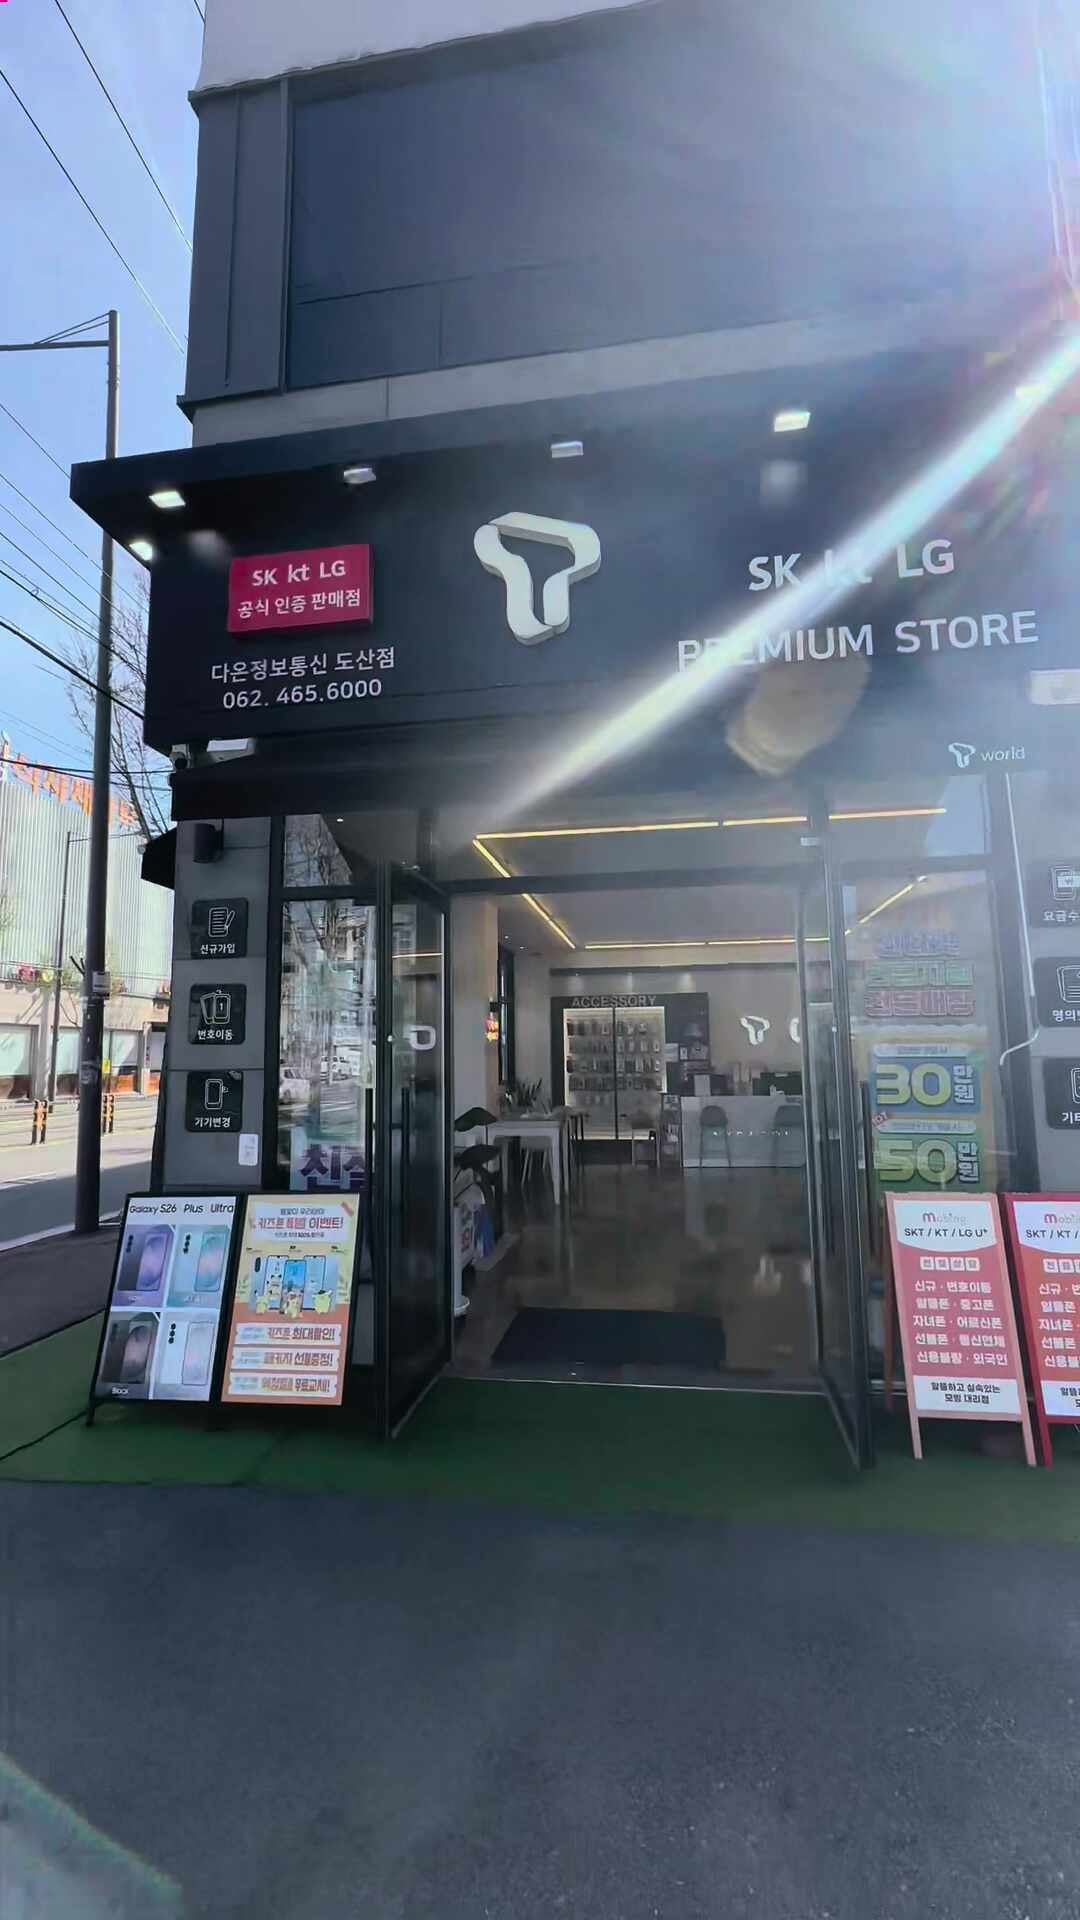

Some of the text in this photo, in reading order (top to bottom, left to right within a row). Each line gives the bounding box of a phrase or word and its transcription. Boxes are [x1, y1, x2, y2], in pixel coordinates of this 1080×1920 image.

[748, 553, 801, 591] SK
[896, 539, 955, 579] LG
[252, 560, 346, 587] SK kt LG
[237, 587, 361, 619] 공식 인증 판매점
[895, 609, 1039, 654] STORE
[211, 646, 395, 684] 다온정보통신 도산점
[276, 679, 382, 704] 465.6000
[981, 746, 1025, 761] world
[200, 943, 235, 955] 신규가입
[572, 995, 657, 1008] ACCESSORY
[198, 1029, 234, 1041] 번호이동
[876, 1062, 951, 1106] 30
[953, 1064, 975, 1104] 만원
[194, 1117, 230, 1128] 기기변경
[878, 1139, 957, 1184] 50
[958, 1142, 979, 1182] 만원
[129, 1203, 235, 1214] Galaxy S26 Plus Ultra
[309, 1217, 344, 1229] 이벤트!
[904, 1228, 924, 1237] SKT
[935, 1228, 948, 1237] KT
[959, 1229, 973, 1237] LG
[1026, 1229, 1046, 1239] SKT
[1057, 1230, 1071, 1239] KT
[915, 1280, 992, 1293] 신규 번호이동
[1039, 1283, 1061, 1295] 신규
[912, 1315, 946, 1327] 자녀폰
[973, 1352, 1008, 1365] 외국인
[1045, 1355, 1080, 1368] 신용불
[931, 1382, 965, 1392] 알뜰하고
[1060, 1387, 1080, 1396] 알뜰
[964, 1394, 989, 1404] 대리점
